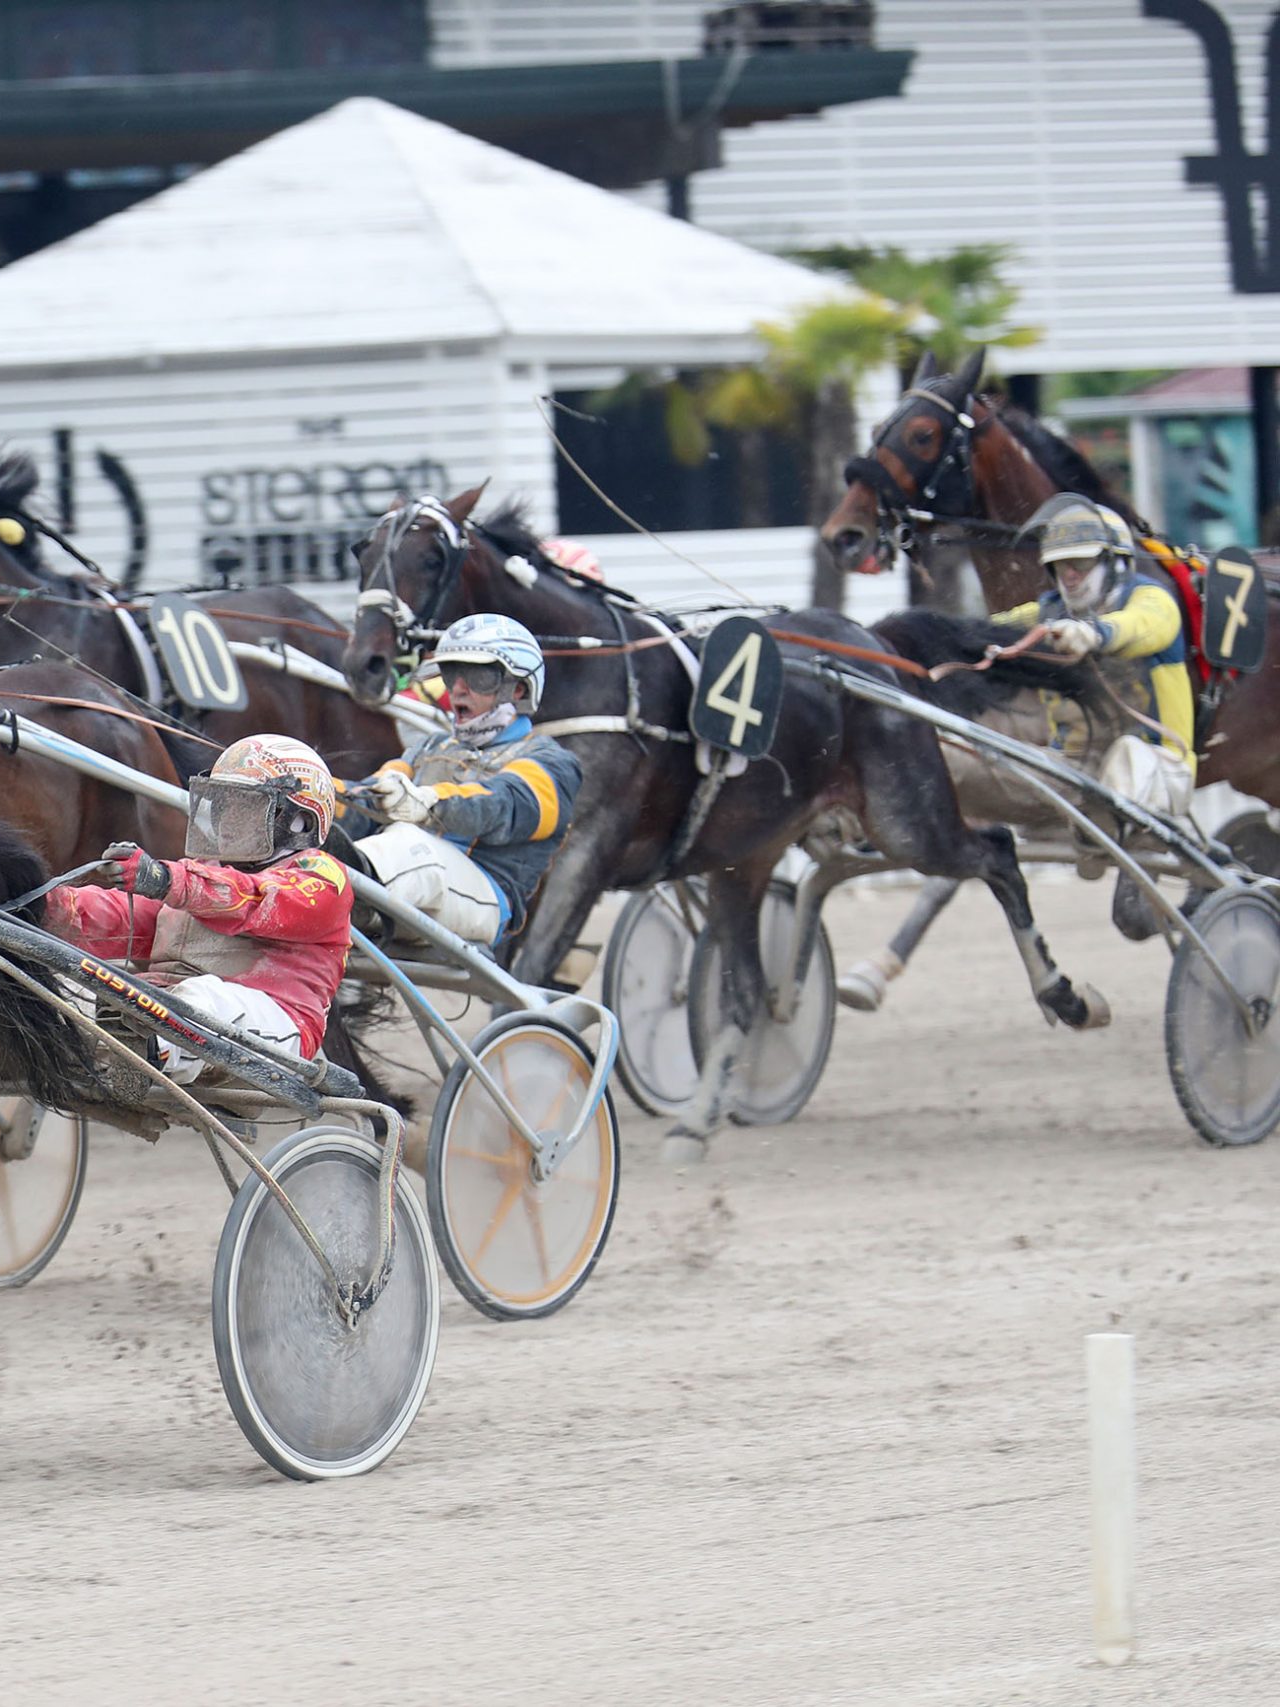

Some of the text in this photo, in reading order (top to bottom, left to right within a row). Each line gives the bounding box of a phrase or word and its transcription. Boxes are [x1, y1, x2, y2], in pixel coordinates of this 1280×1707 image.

[157, 606, 240, 704] 10
[1216, 558, 1255, 658] 7
[706, 631, 763, 747] 4
[80, 957, 170, 1021] CUSTOM
